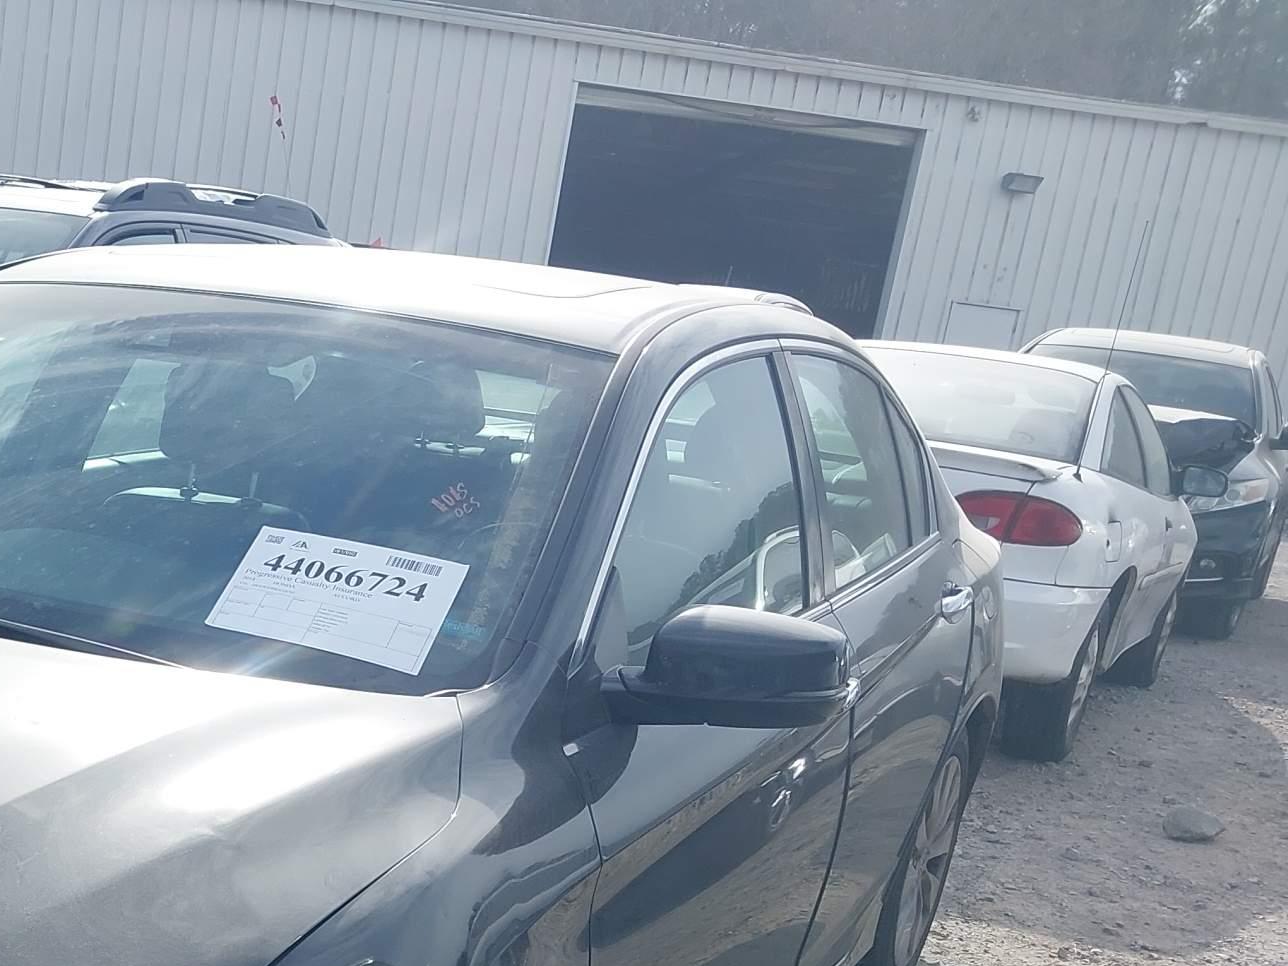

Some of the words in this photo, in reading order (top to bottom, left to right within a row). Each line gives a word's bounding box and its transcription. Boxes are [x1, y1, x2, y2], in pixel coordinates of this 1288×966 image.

[245, 568, 293, 582] Progressive
[294, 577, 329, 590] Casualty
[332, 585, 374, 599] Insurance
[263, 554, 428, 602] 44066724
